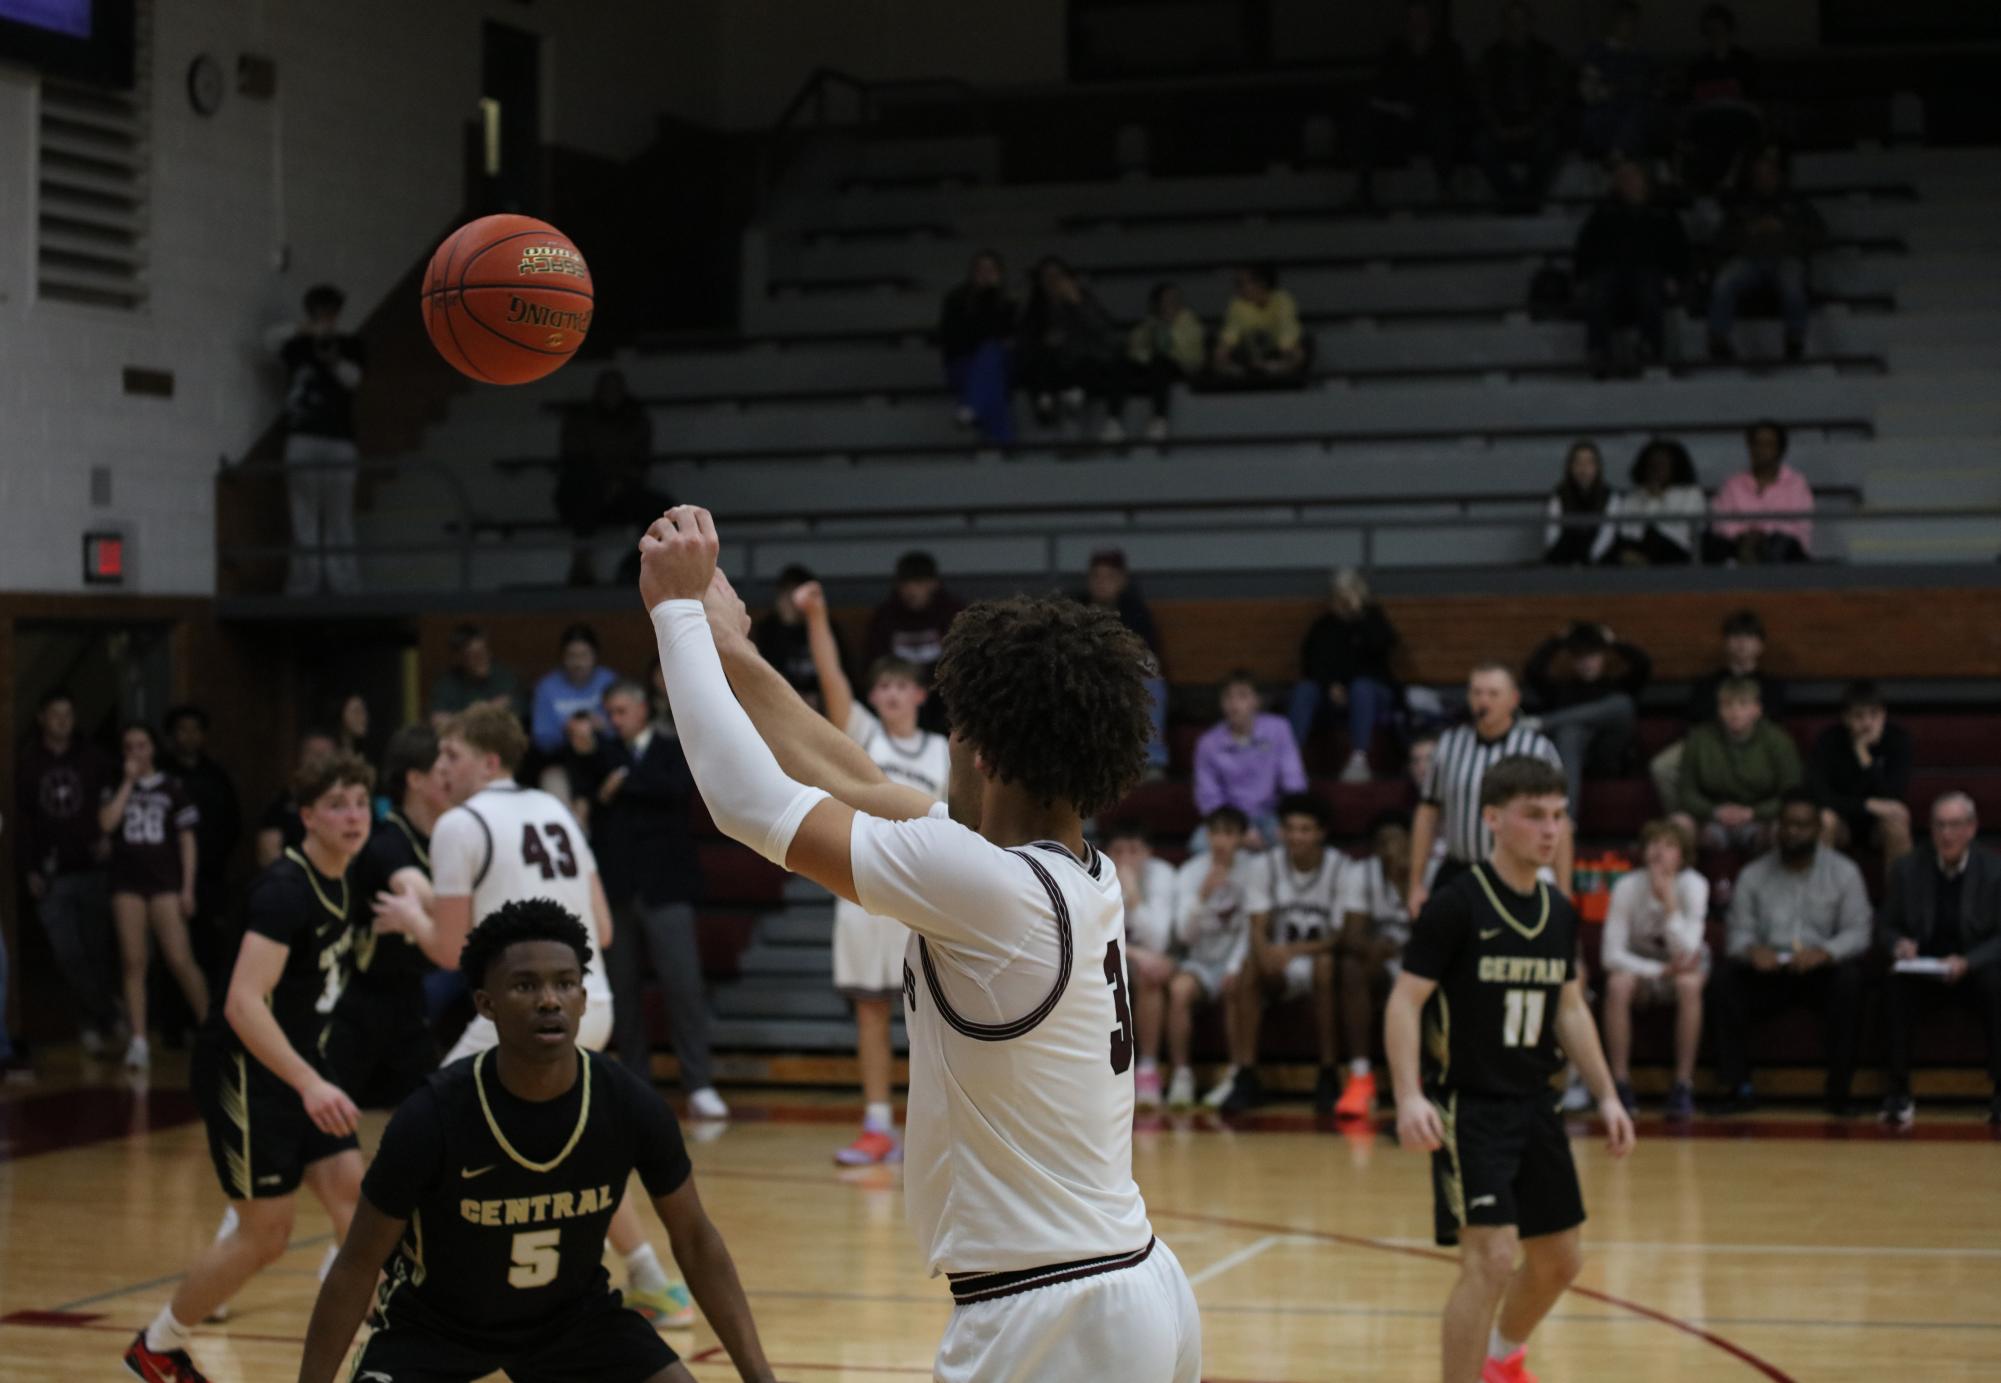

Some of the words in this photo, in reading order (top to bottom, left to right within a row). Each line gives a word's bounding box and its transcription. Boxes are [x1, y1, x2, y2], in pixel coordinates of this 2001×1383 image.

[507, 295, 593, 334] PALDING
[522, 822, 577, 879] 43
[1504, 989, 1546, 1047] 11
[460, 1185, 612, 1226] CENTRAL
[507, 1229, 561, 1289] 5
